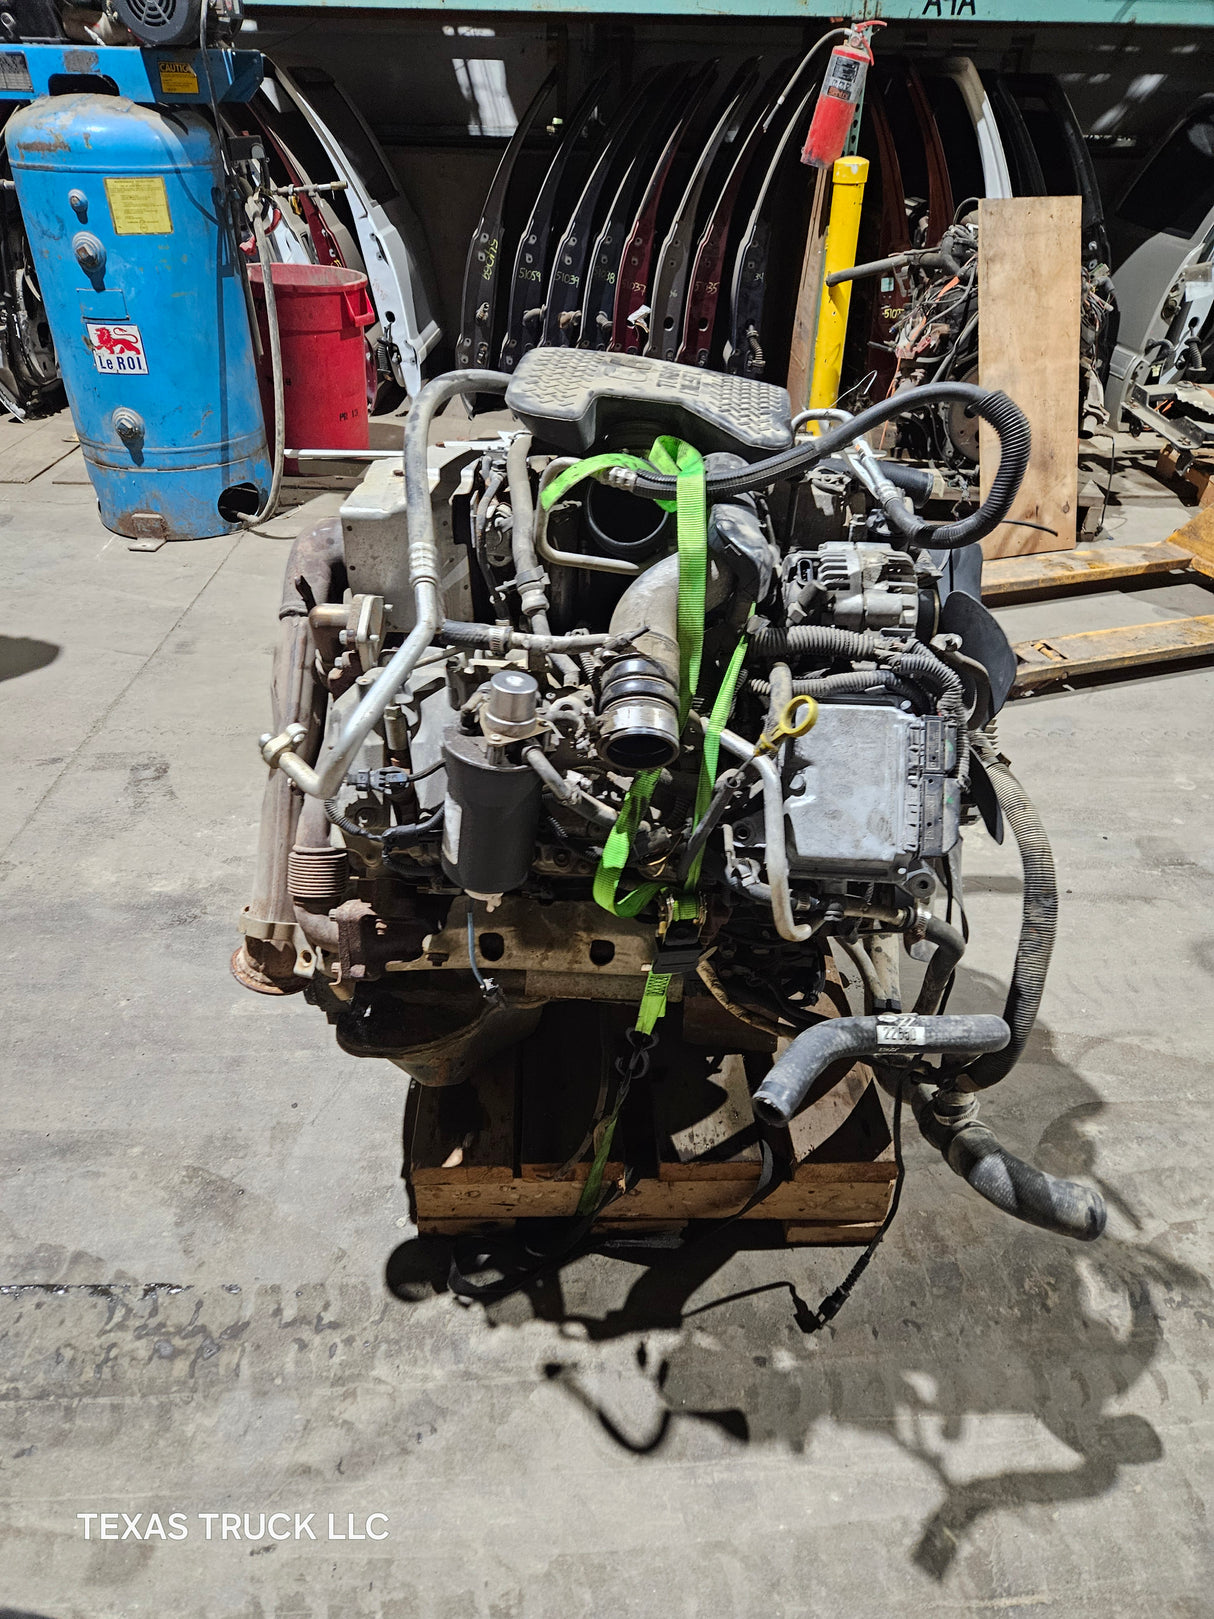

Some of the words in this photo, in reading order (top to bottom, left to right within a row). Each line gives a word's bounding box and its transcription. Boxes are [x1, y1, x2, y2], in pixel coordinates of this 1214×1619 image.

[160, 63, 190, 72] CAUTIO
[519, 267, 541, 282] 51059
[98, 355, 114, 370] Le
[116, 356, 142, 370] ROI
